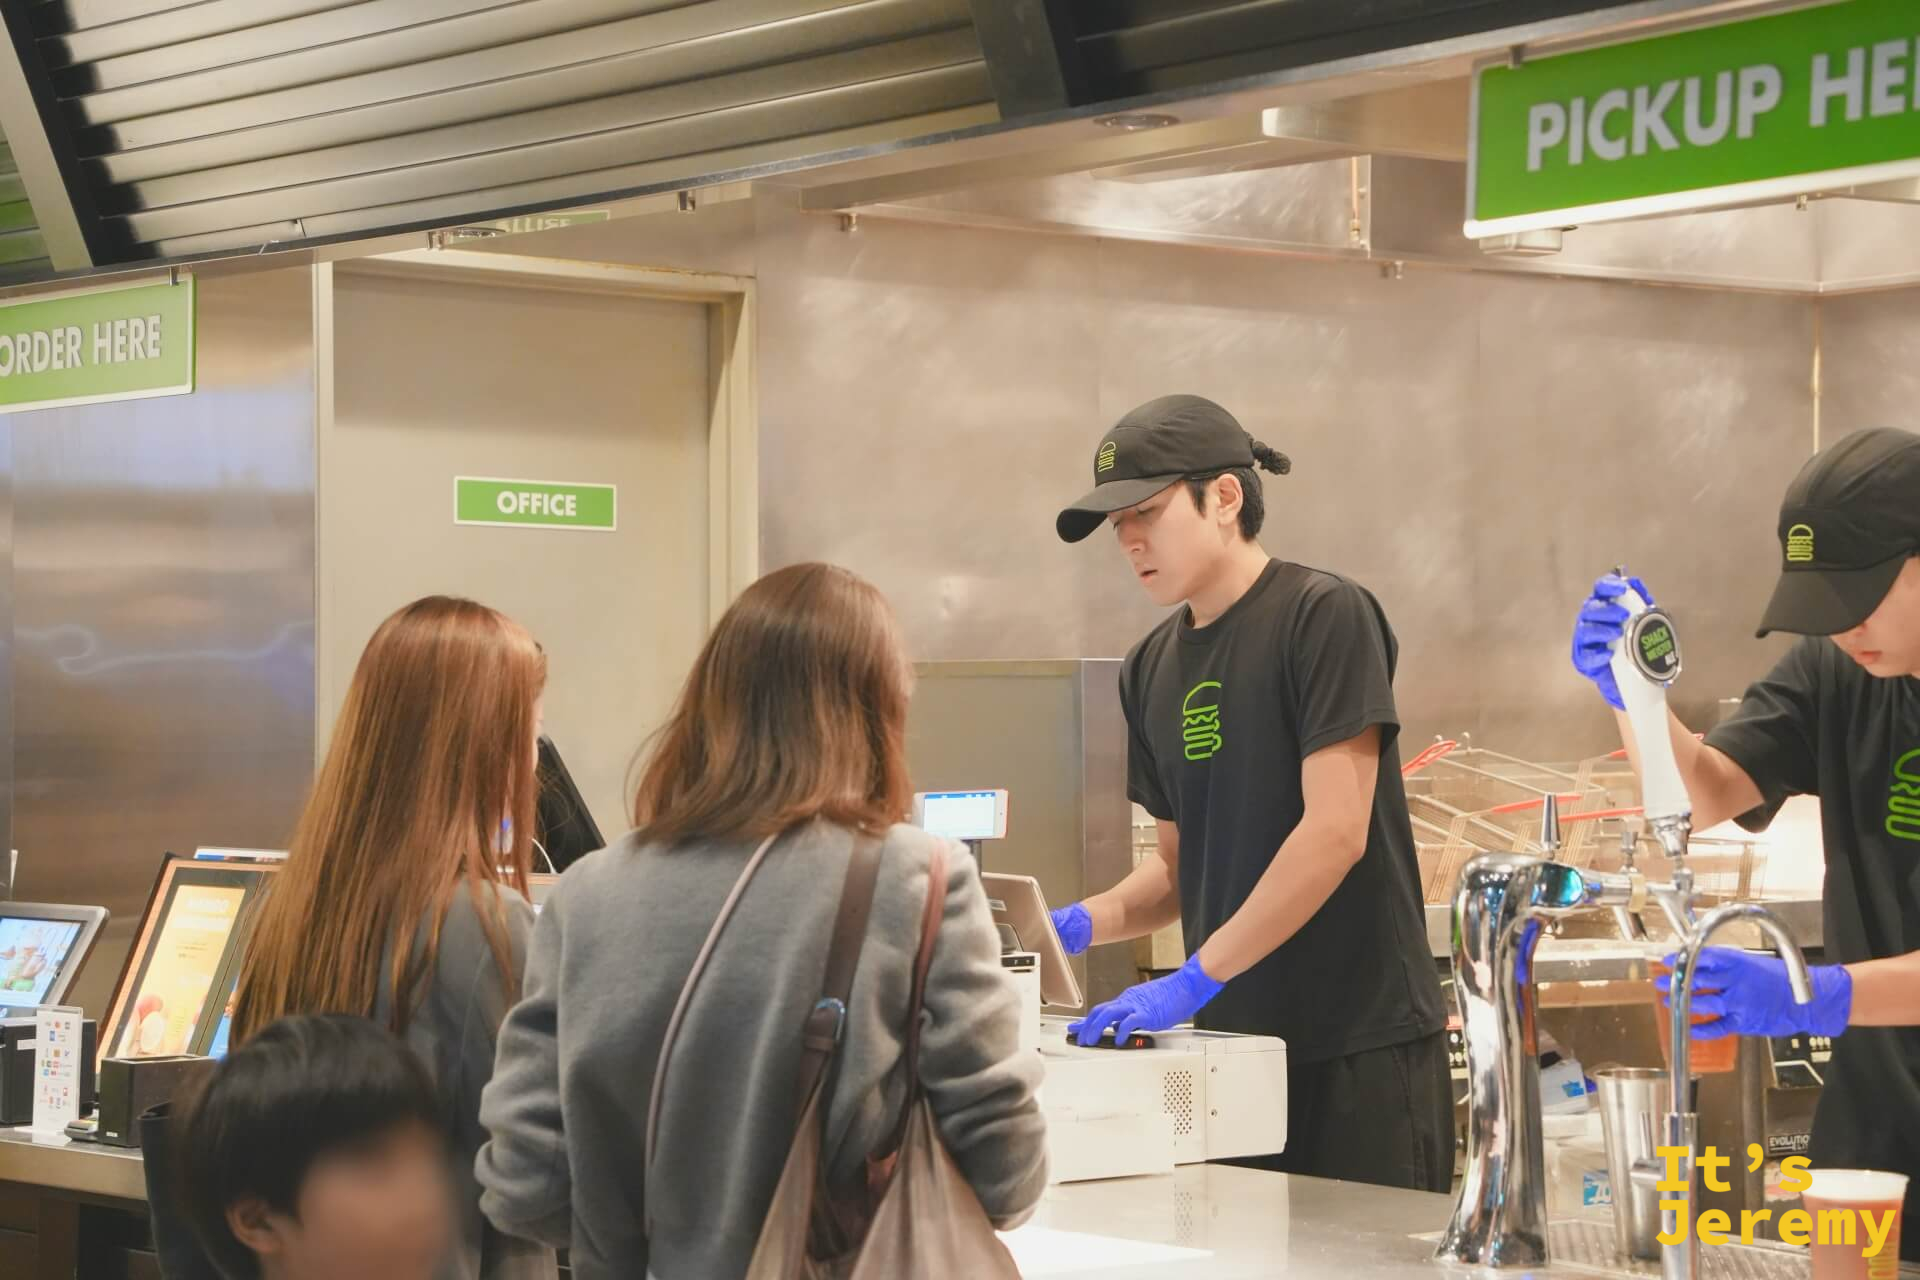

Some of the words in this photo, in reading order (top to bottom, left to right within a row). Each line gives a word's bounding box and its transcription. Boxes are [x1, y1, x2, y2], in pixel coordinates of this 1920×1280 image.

[1526, 63, 1783, 172] PICKUP
[1809, 36, 1920, 127] HE
[0, 326, 82, 377] ORDER
[93, 314, 161, 365] HERE
[496, 490, 577, 517] OFFICE
[1769, 1134, 1811, 1147] EVOLUTIO
